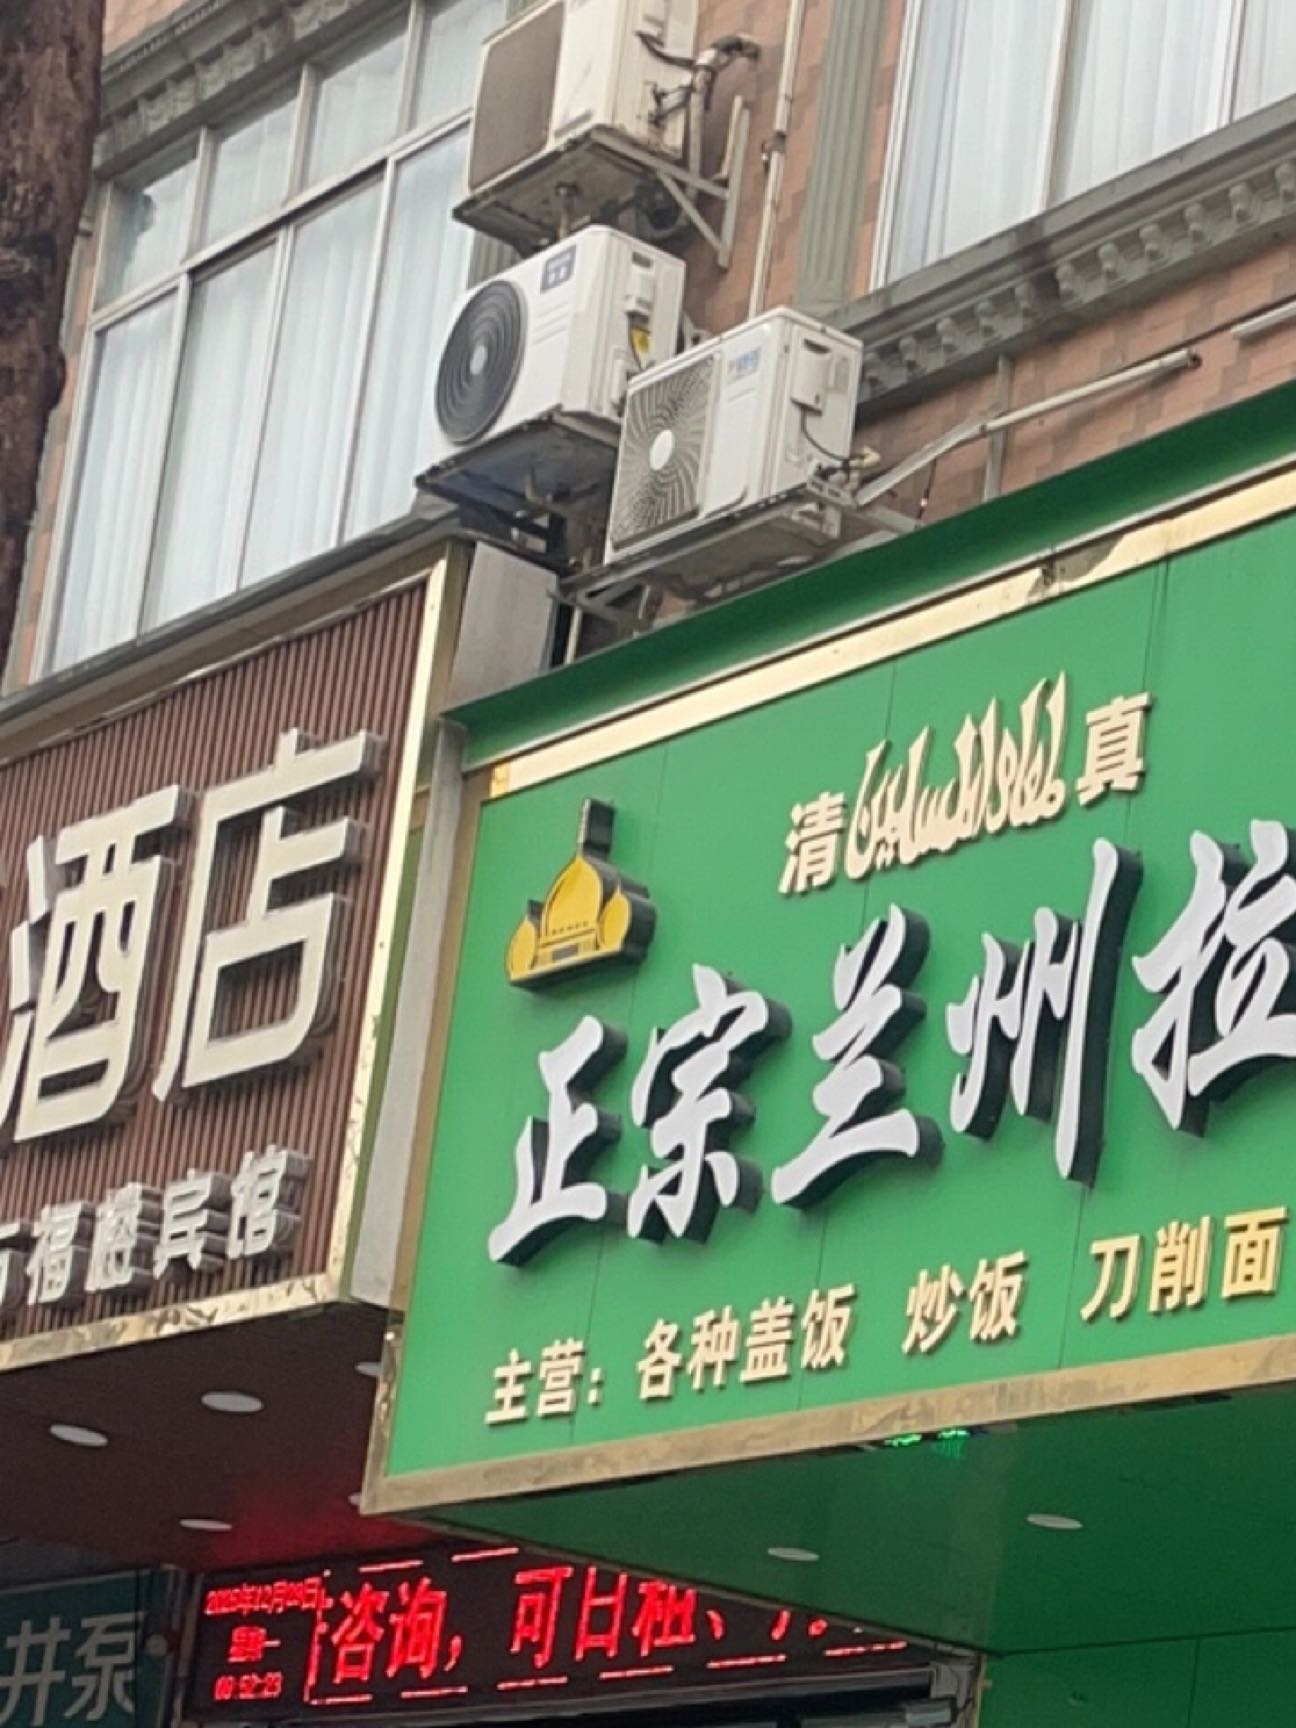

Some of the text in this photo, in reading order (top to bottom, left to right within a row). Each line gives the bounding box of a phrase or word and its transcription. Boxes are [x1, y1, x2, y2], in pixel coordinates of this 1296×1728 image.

[778, 692, 1151, 894] 清 真
[0, 728, 375, 1143] 酒店
[635, 1283, 857, 1401] 各种盖饭
[902, 1252, 1029, 1356] 炒饭
[1080, 1206, 1289, 1322] 刀削面
[0, 1611, 143, 1728] 井泵
